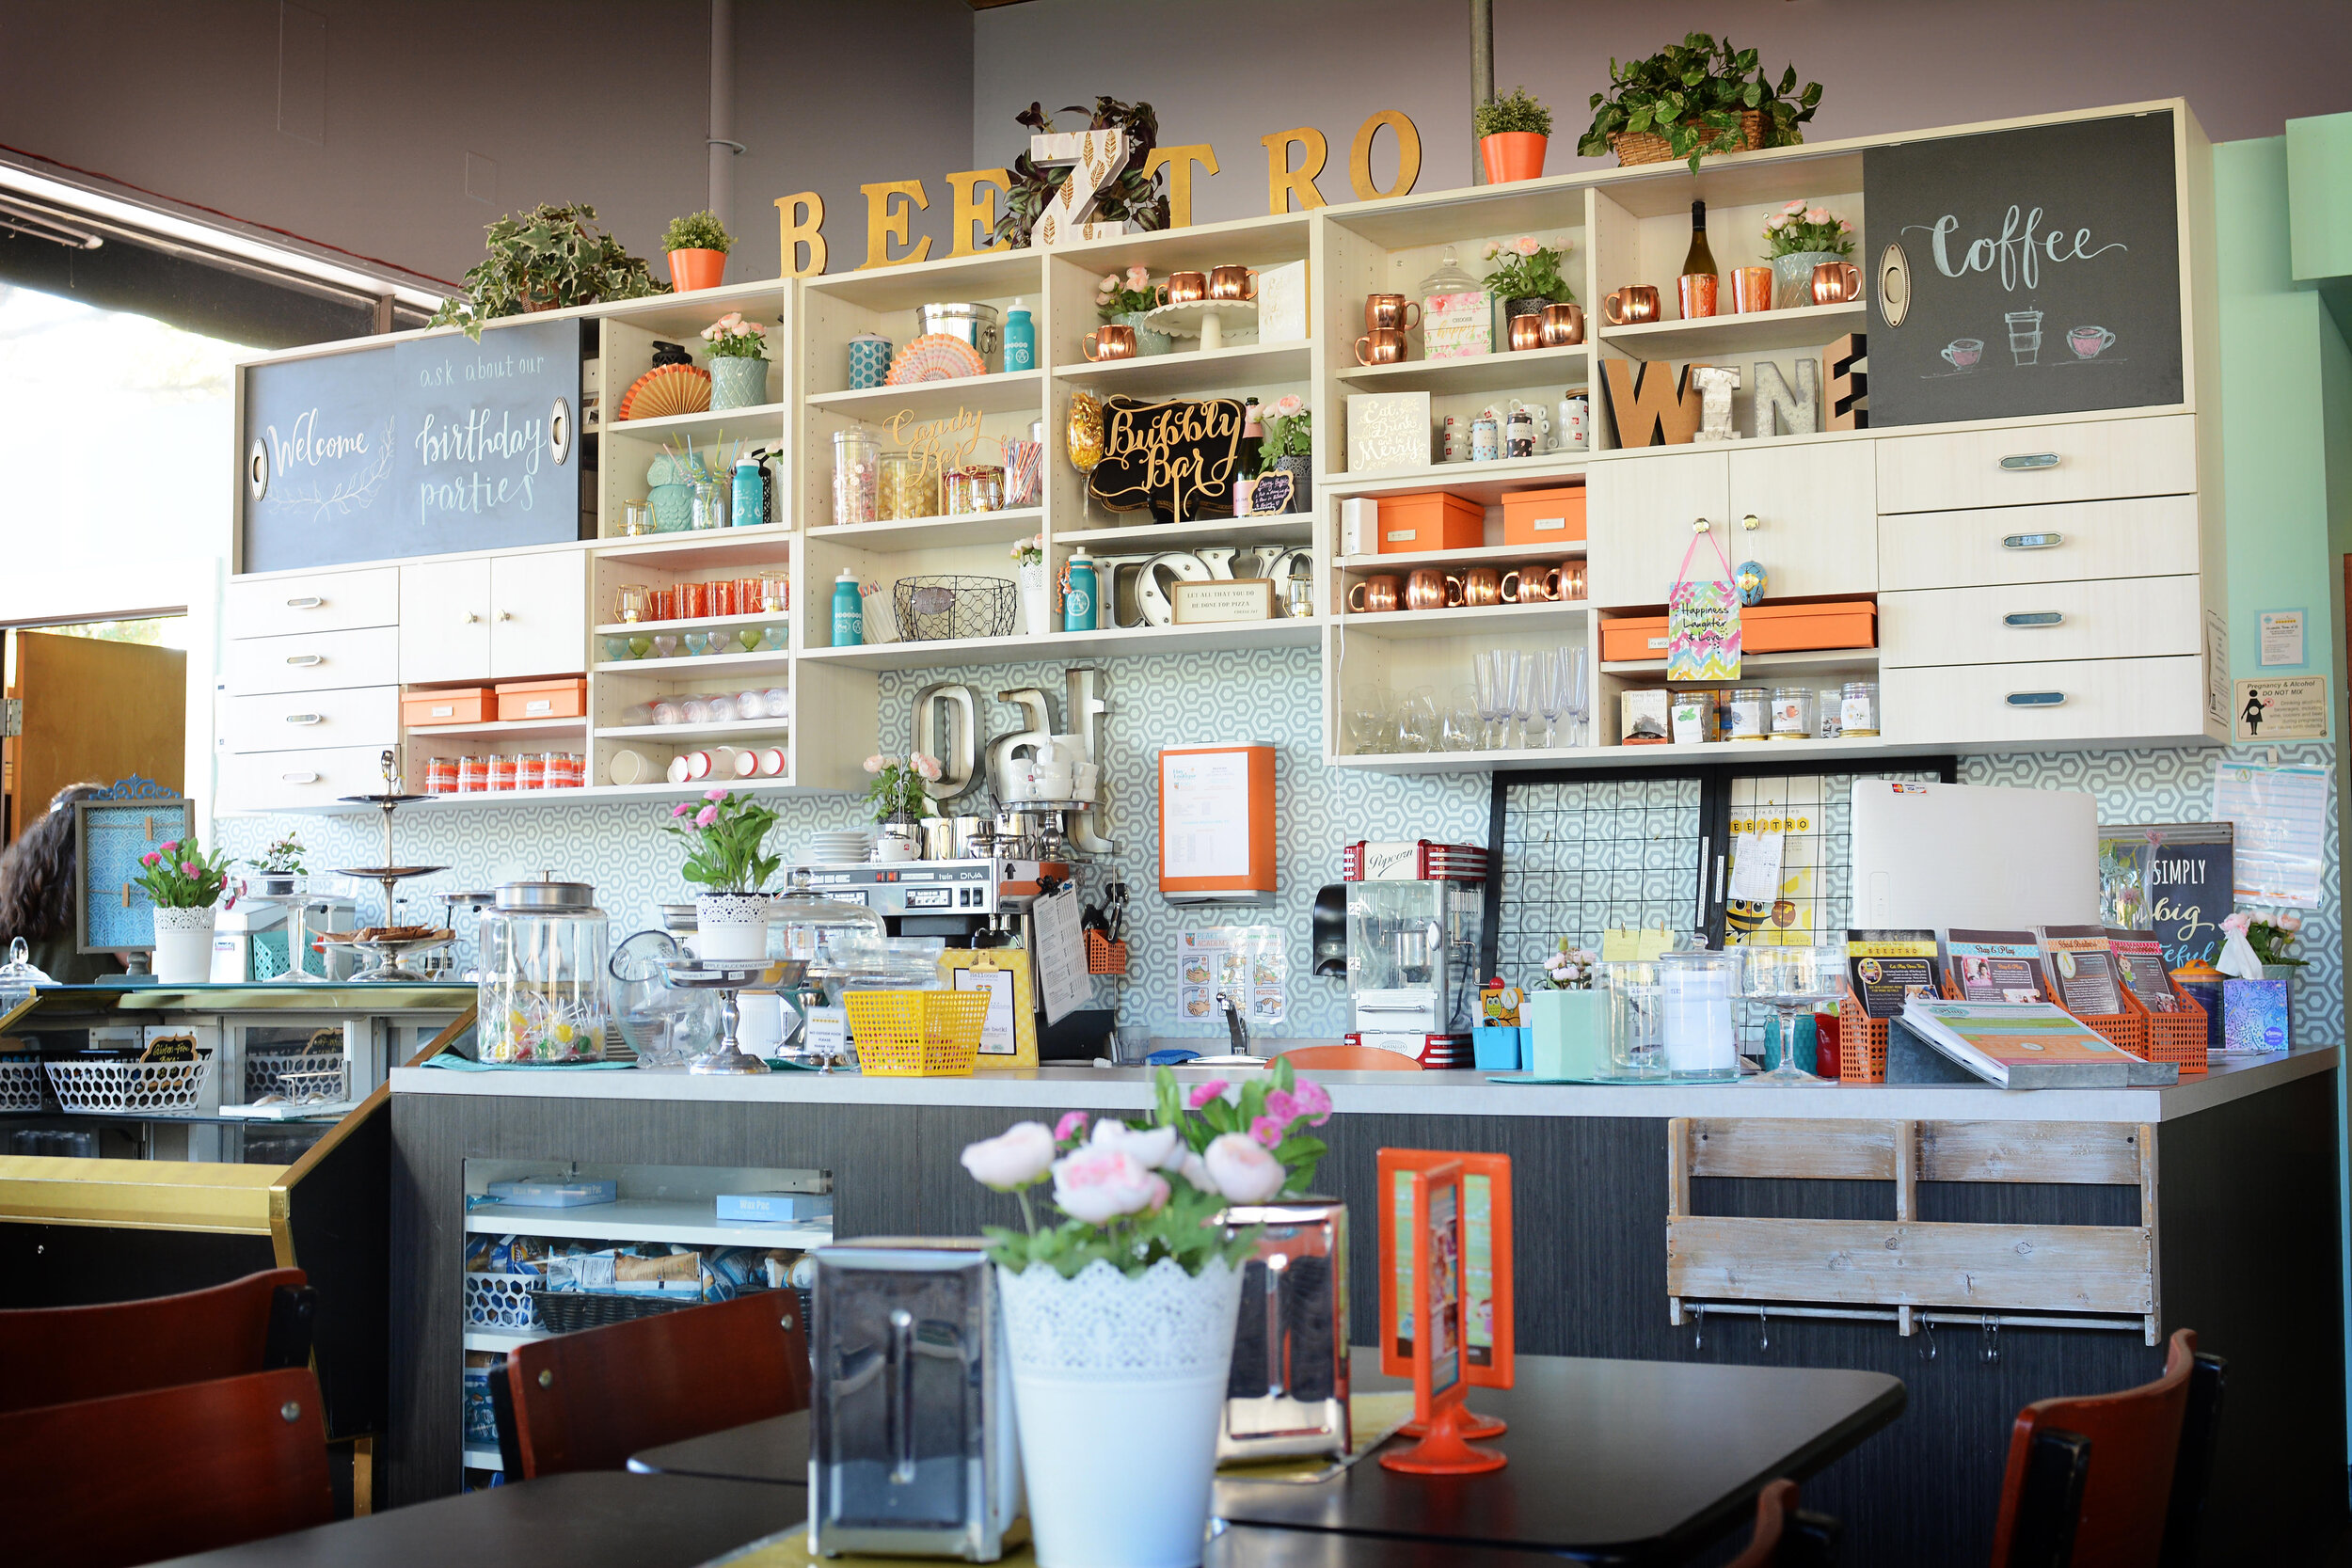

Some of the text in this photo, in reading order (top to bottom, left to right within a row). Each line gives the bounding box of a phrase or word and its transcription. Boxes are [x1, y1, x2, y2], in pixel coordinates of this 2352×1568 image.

[1901, 205, 2128, 292] Coffee
[1437, 320, 1476, 340] happy
[421, 355, 545, 388] ask about our
[1598, 333, 1868, 450] WINE
[267, 407, 370, 477] Welcome
[415, 408, 547, 475] birthday
[882, 405, 993, 455] Candy
[1104, 394, 1241, 483] Bubbly
[904, 435, 979, 488] Bar
[1354, 436, 1426, 470] Merry
[421, 472, 534, 525] parties
[1681, 601, 1730, 618] Happiness
[1682, 617, 1727, 632] Laughter
[1697, 631, 1724, 641] Love
[2247, 682, 2282, 690] Pregnancy
[1733, 820, 1807, 832] EETRO
[1369, 849, 1413, 870] Popcorn
[2153, 859, 2206, 885] SIMPLY
[960, 872, 984, 880] DIVA
[2153, 896, 2216, 942] big
[1997, 945, 2015, 956] Play
[739, 1199, 771, 1211] Wax Pac
